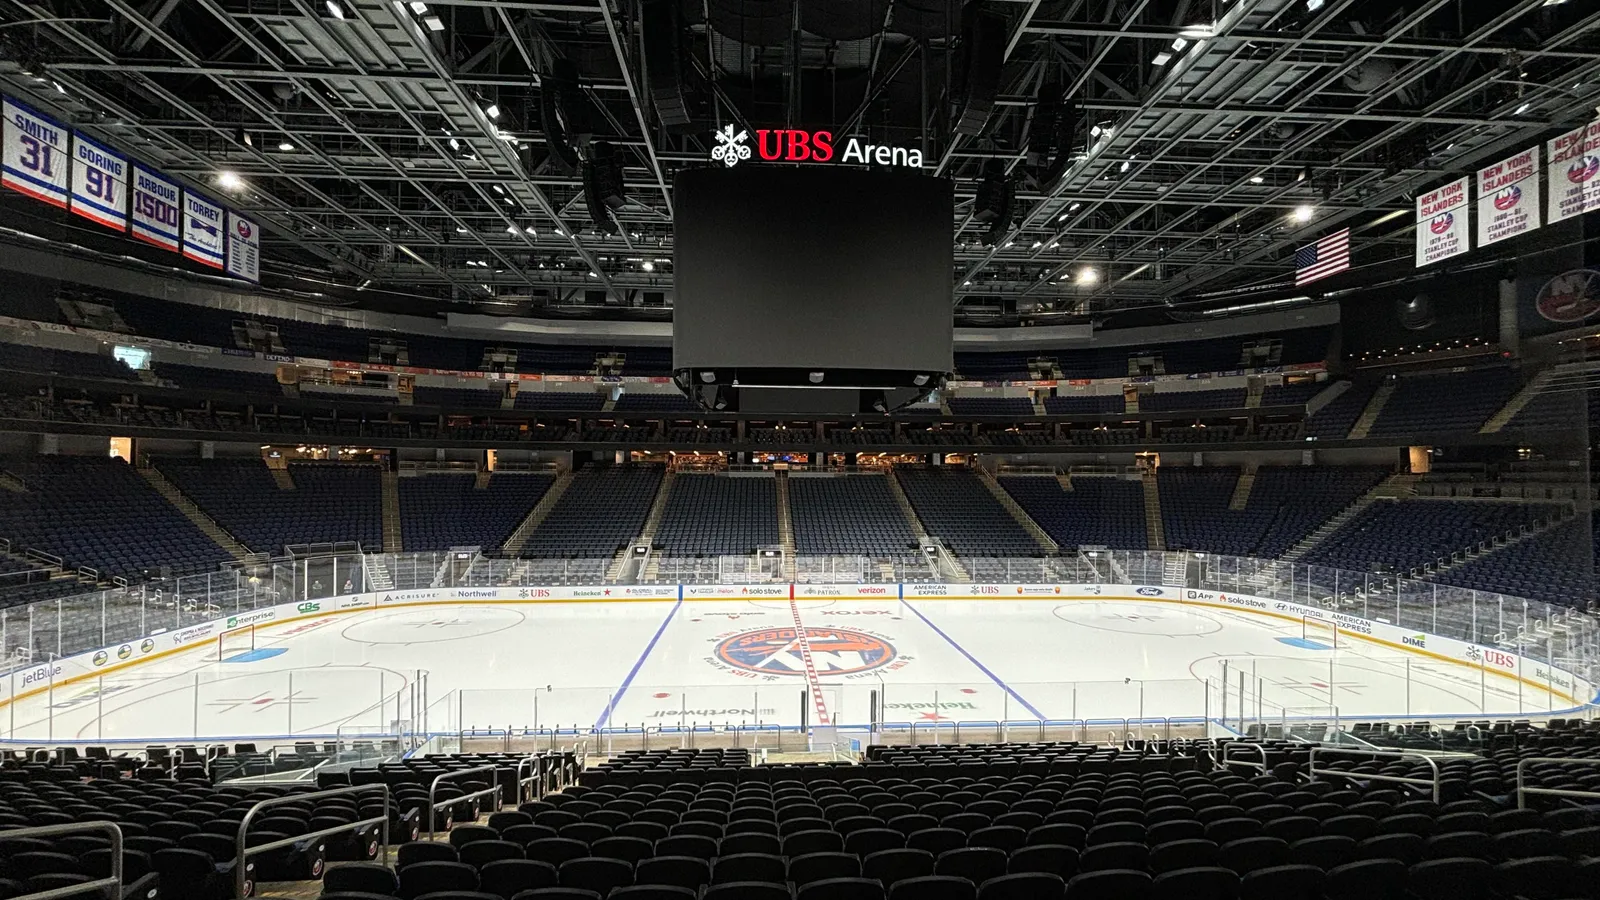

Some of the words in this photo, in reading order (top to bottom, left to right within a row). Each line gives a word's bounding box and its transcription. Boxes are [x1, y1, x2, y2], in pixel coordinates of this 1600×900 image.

[15, 114, 58, 146] SMITH
[756, 129, 834, 162] UBS
[842, 138, 923, 168] Arena
[1554, 132, 1579, 151] NEW
[20, 134, 53, 178] 31
[79, 145, 122, 176] GORING
[1483, 164, 1503, 180] NEW
[1506, 151, 1532, 170] YORK
[86, 166, 115, 204] 91
[1482, 165, 1533, 193] ISLANDERS
[138, 175, 176, 202] ARBOUR
[1421, 191, 1438, 206] NEW
[1441, 181, 1463, 197] YORK
[134, 190, 177, 228] 1500
[188, 198, 220, 222] TORREY
[1421, 193, 1464, 217] ISLANDERS
[1488, 218, 1514, 233] STANLEY
[1515, 213, 1528, 224] CUP
[1489, 223, 1527, 241] CHAMPIONS
[1424, 241, 1447, 255] STANLEY
[1448, 238, 1459, 247] CUP
[1426, 247, 1458, 261] CHAMPIONS
[530, 589, 550, 597] UBS
[857, 586, 886, 594] verizon
[981, 586, 999, 594] UBS
[1141, 588, 1159, 596] Ford
[297, 603, 321, 613] CBS
[1227, 594, 1244, 604] solo
[1245, 597, 1266, 609] stove
[1289, 605, 1323, 618] HYUNDAI
[1331, 612, 1372, 628] AMERICAN
[1336, 621, 1372, 635] EXPRESS
[1402, 635, 1426, 648] DIME
[1484, 650, 1514, 669] UBS
[21, 665, 62, 688] jetBlue
[729, 669, 759, 678] UBS
[845, 668, 888, 680] Arena
[647, 709, 756, 718] Northwell
